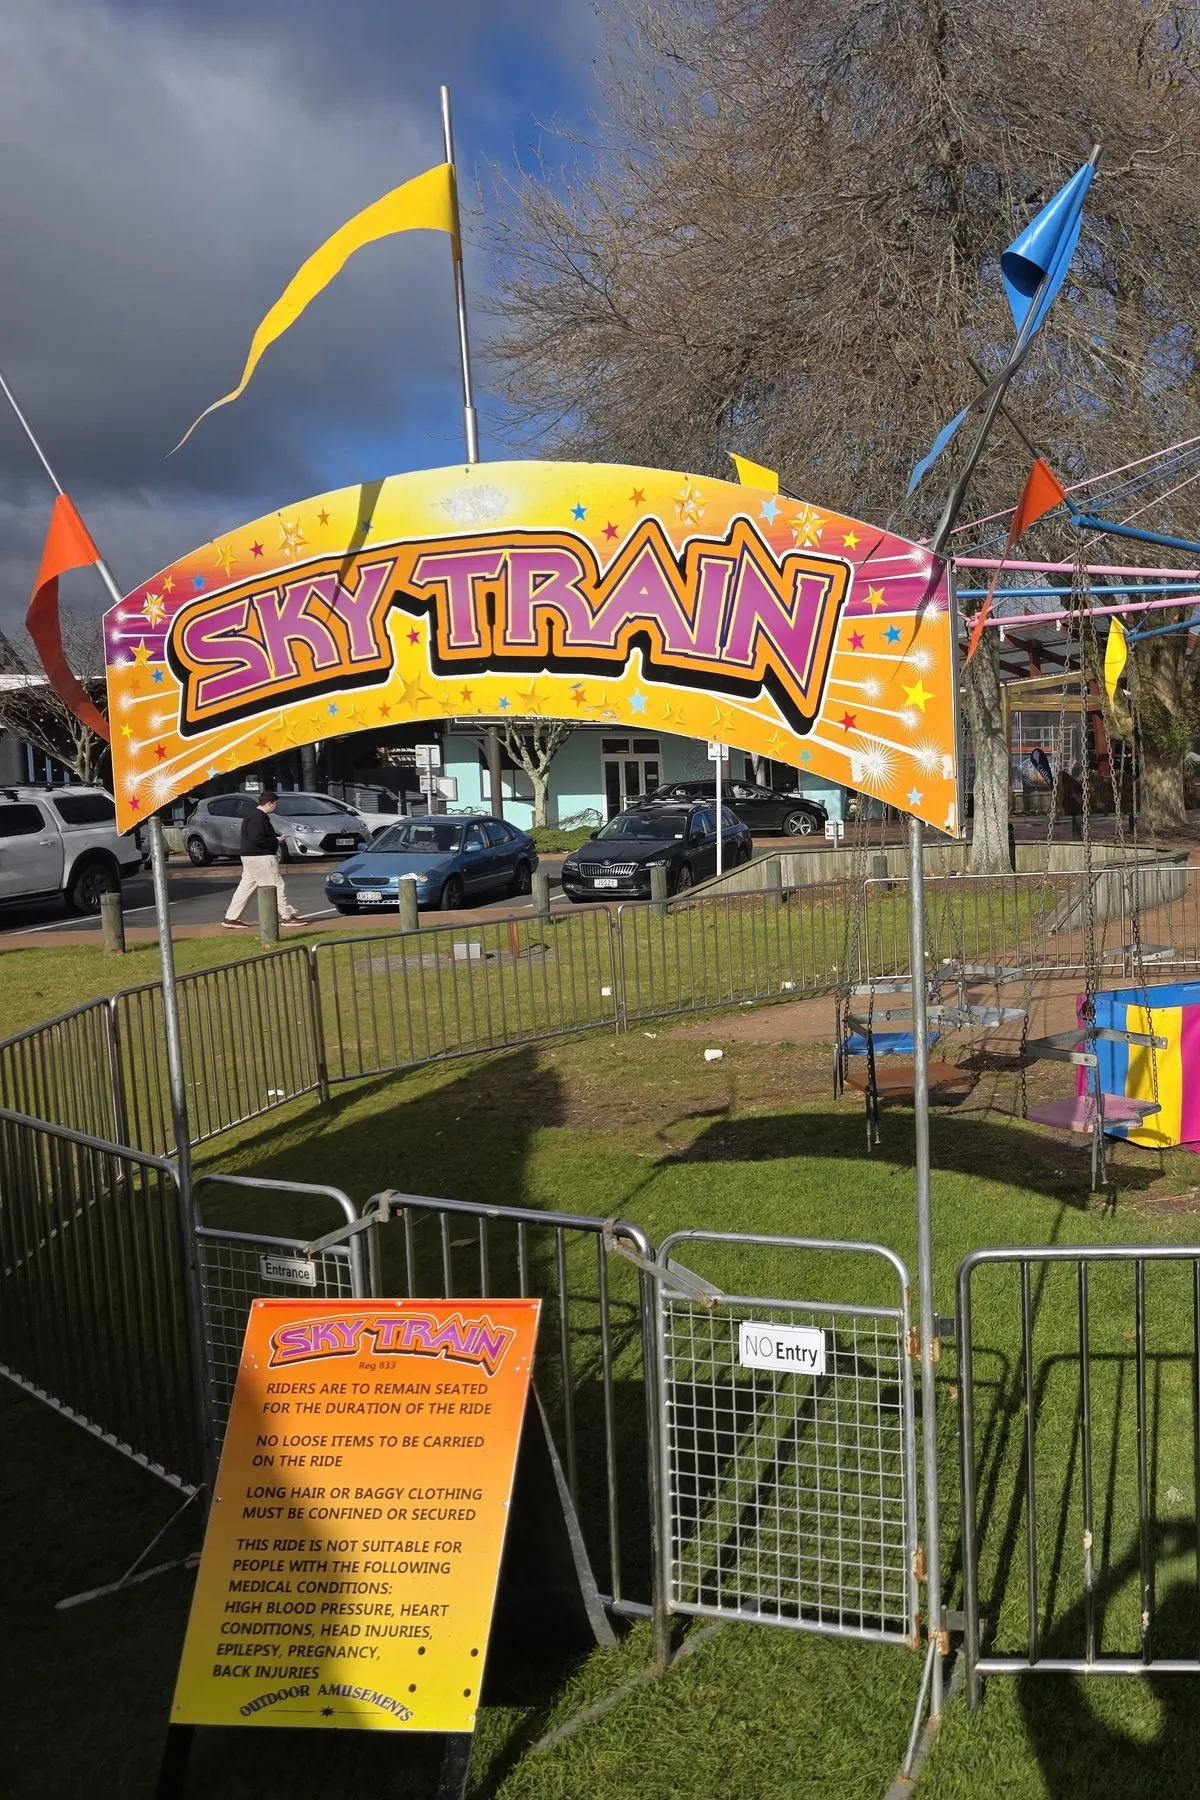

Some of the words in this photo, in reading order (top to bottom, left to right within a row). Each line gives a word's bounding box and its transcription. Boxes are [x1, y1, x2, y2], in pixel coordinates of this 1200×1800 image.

[182, 561, 396, 706] SKY
[411, 531, 831, 695] TRAIN
[265, 1262, 310, 1280] Entrance
[278, 1318, 367, 1358] SKY
[373, 1316, 508, 1364] TRAIN
[745, 1334, 774, 1358] NO
[775, 1341, 818, 1368] Entry
[358, 1361, 376, 1371] Reg
[378, 1361, 396, 1370] 833
[266, 1382, 316, 1394] RIDERS
[319, 1383, 348, 1394] ARE
[351, 1383, 370, 1395] TO
[374, 1383, 431, 1395] REMAIN
[435, 1383, 489, 1395] SEATED
[262, 1402, 290, 1414] FOR
[295, 1402, 321, 1414] THE
[325, 1402, 402, 1414] DURATION
[405, 1402, 424, 1414] OF
[428, 1402, 455, 1414] THE
[459, 1402, 493, 1414] RIDE
[256, 1435, 279, 1447] NO
[282, 1435, 328, 1447] LOOSE
[330, 1435, 374, 1447] ITEMS
[379, 1435, 398, 1447] TO
[402, 1435, 419, 1447] BE
[423, 1435, 485, 1447] CARRIED
[252, 1455, 275, 1467] ON
[279, 1455, 306, 1467] THE
[310, 1455, 343, 1467] RIDE
[246, 1487, 287, 1499] LONG
[290, 1487, 326, 1499] HAIR
[330, 1487, 351, 1499] OR
[354, 1487, 405, 1499] BAGGY
[408, 1488, 483, 1500] CLOTHING
[242, 1507, 284, 1519] MUST
[287, 1507, 305, 1519] BE
[308, 1507, 383, 1519] CONFINED
[386, 1508, 408, 1520] OR
[411, 1508, 477, 1521] SECURED
[237, 1539, 269, 1551] THIS
[273, 1539, 306, 1551] RIDE
[308, 1539, 322, 1551] IS
[326, 1540, 359, 1552] NOT
[361, 1540, 430, 1553] SUITABLE
[433, 1541, 463, 1553] FOR
[232, 1559, 285, 1572] PEOPLE
[288, 1560, 328, 1572] WITH
[332, 1561, 360, 1573] THE
[363, 1561, 451, 1574] FOLLOWING
[228, 1580, 293, 1593] MEDICAL
[296, 1581, 393, 1595] CONDITIONS:
[224, 1601, 262, 1614] HIGH
[265, 1602, 317, 1615] BLOOD
[320, 1603, 396, 1618] PRESSURE,
[400, 1604, 450, 1617] HEART
[220, 1622, 316, 1638] CONDITIONS,
[320, 1624, 361, 1637] HEAD
[364, 1625, 433, 1640] INJURIES,
[216, 1643, 284, 1660] EPILEPSY,
[287, 1645, 381, 1661] PREGNANCY,
[212, 1664, 252, 1678] BACK
[254, 1665, 320, 1680] INJURIES
[239, 1684, 311, 1717] OUTDOOR
[317, 1683, 416, 1723] AMUSEMENTS
